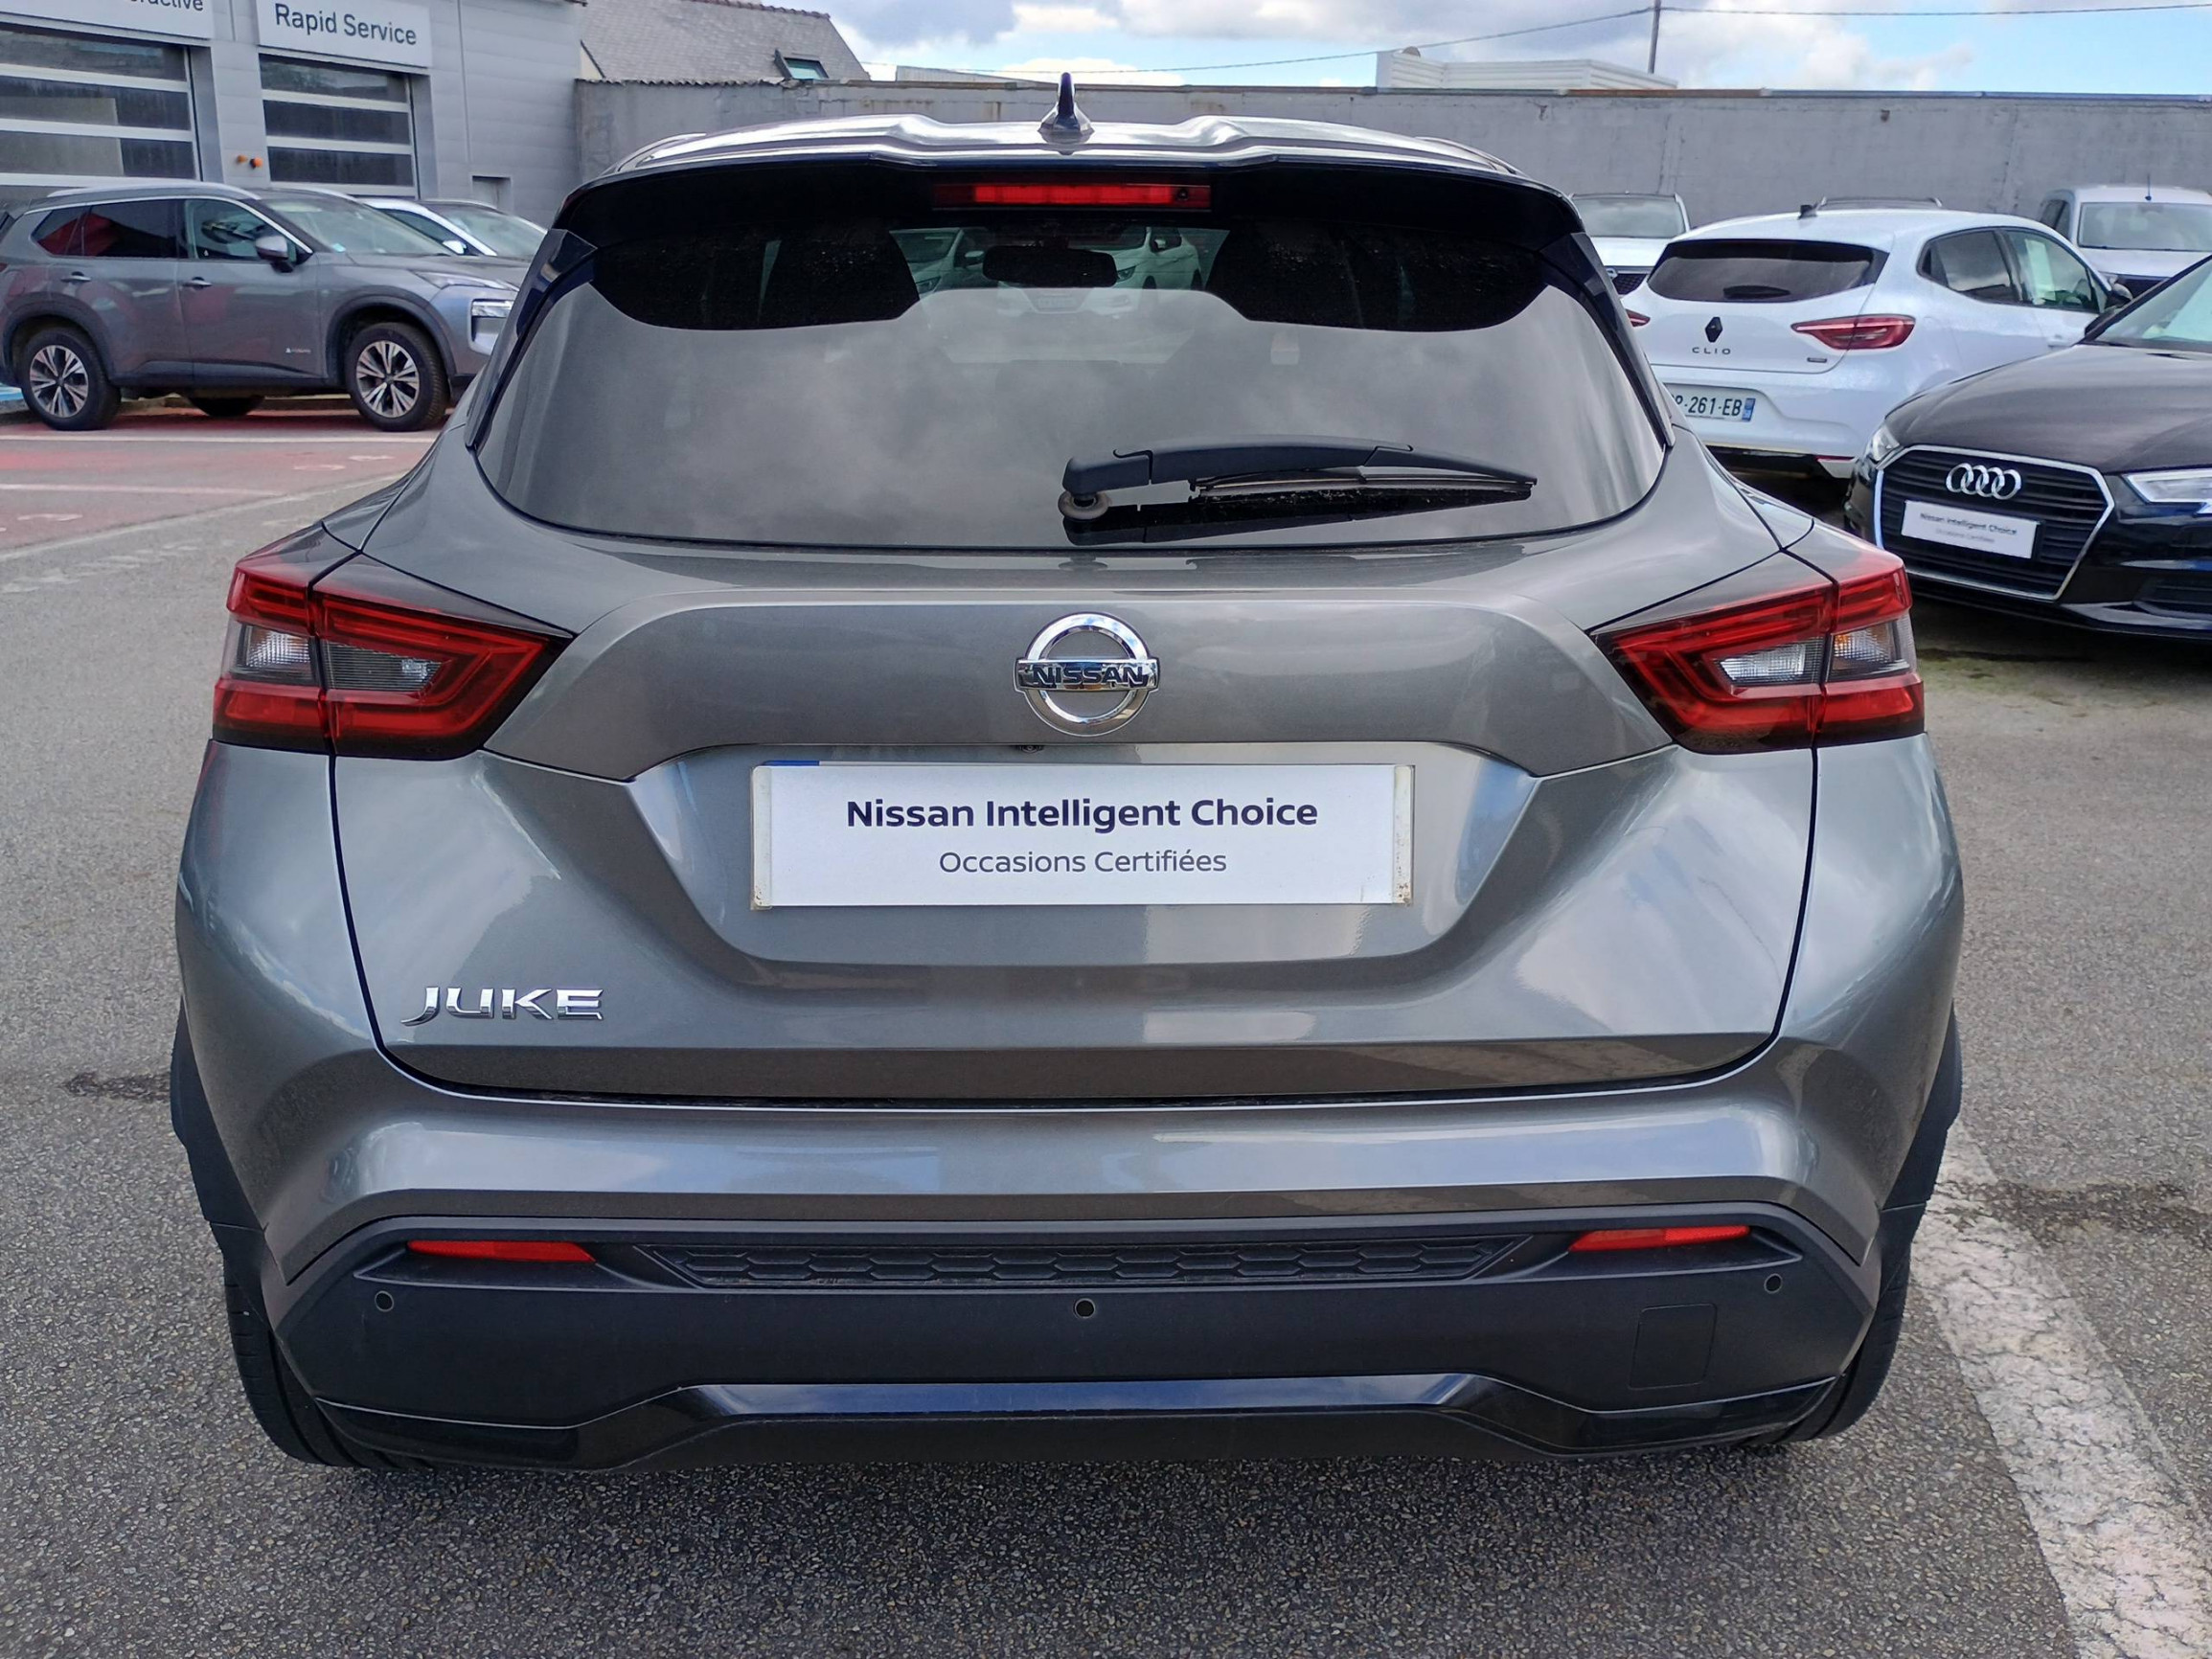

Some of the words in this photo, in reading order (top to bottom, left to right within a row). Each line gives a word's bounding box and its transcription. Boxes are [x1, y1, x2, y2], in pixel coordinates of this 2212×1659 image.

[275, 3, 337, 34] Rapid
[343, 13, 417, 45] Service
[1692, 347, 1731, 355] CLIO
[1672, 395, 1743, 417] P-261-EB
[1033, 666, 1145, 686] NISSAN
[847, 799, 974, 827] Nissan
[986, 798, 1181, 833] Intelligent
[1191, 797, 1318, 826] Choice
[939, 852, 1086, 873] Occasions
[1094, 849, 1227, 873] Certifiées
[400, 987, 604, 1026] JUKE
